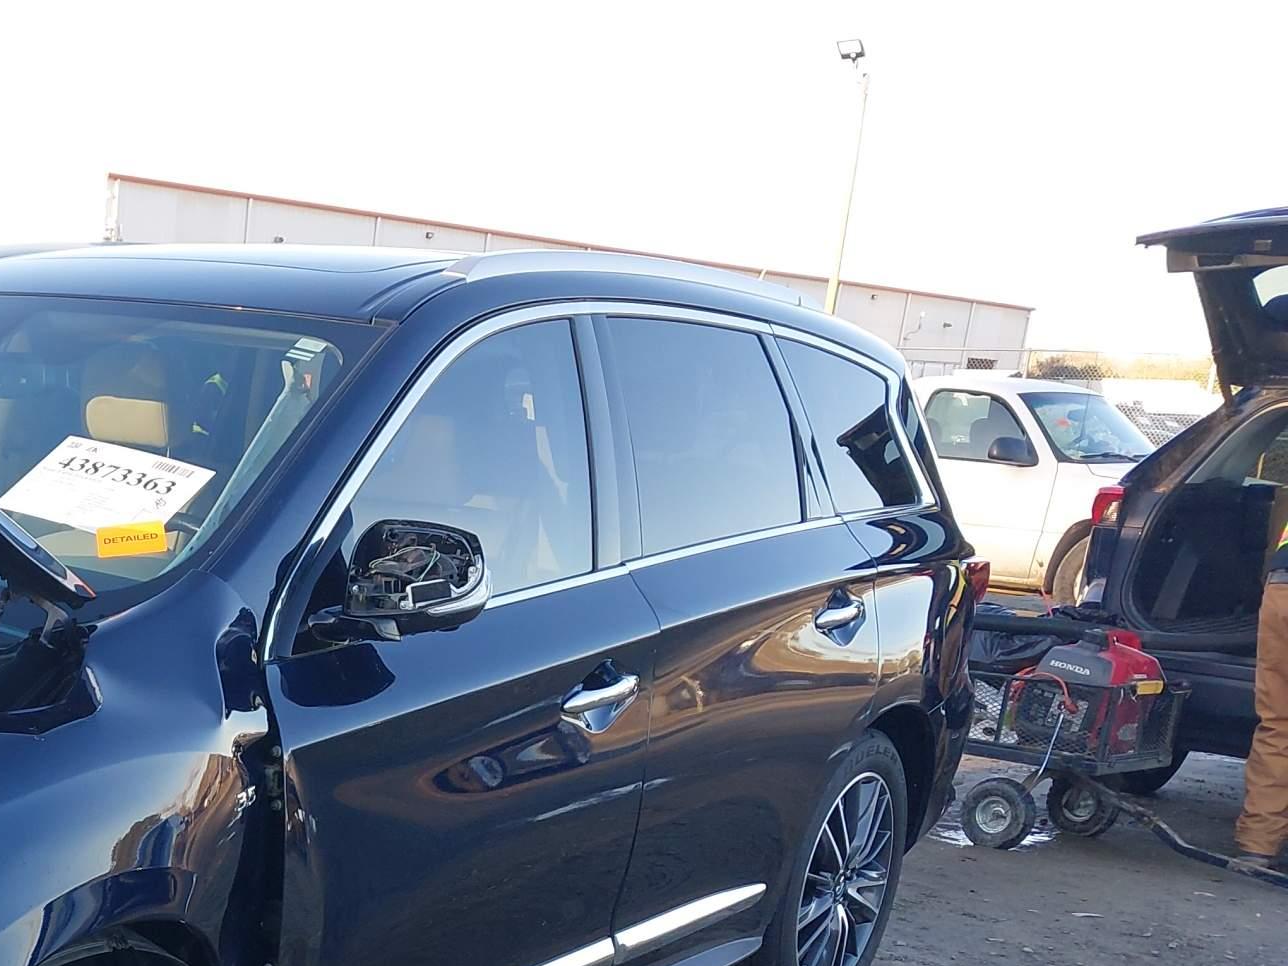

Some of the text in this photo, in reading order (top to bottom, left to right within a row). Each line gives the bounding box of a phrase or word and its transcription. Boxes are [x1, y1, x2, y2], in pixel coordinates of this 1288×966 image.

[57, 455, 178, 496] 43873363
[103, 531, 159, 546] DETAILED
[1049, 659, 1091, 676] HONDA
